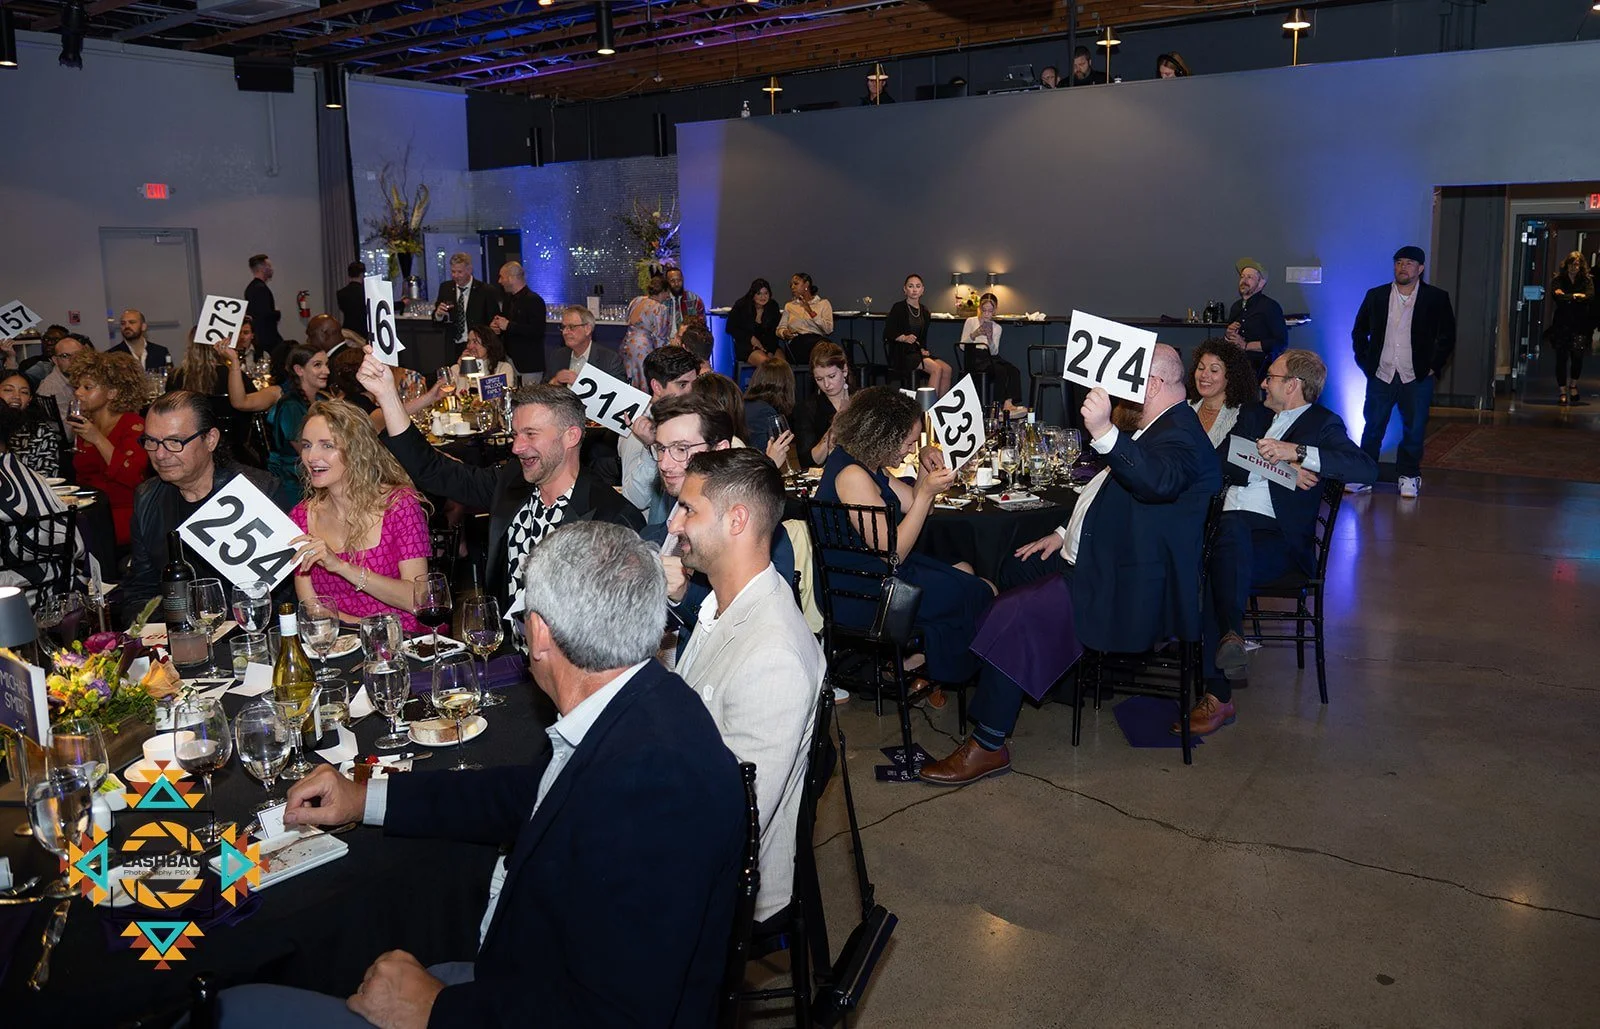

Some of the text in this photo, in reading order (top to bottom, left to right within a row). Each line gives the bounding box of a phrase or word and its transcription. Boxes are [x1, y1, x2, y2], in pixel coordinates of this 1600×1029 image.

[205, 300, 241, 342] 273
[1067, 329, 1146, 393] 274
[578, 377, 640, 430] 214
[934, 389, 976, 470] 232
[186, 495, 298, 590] 254
